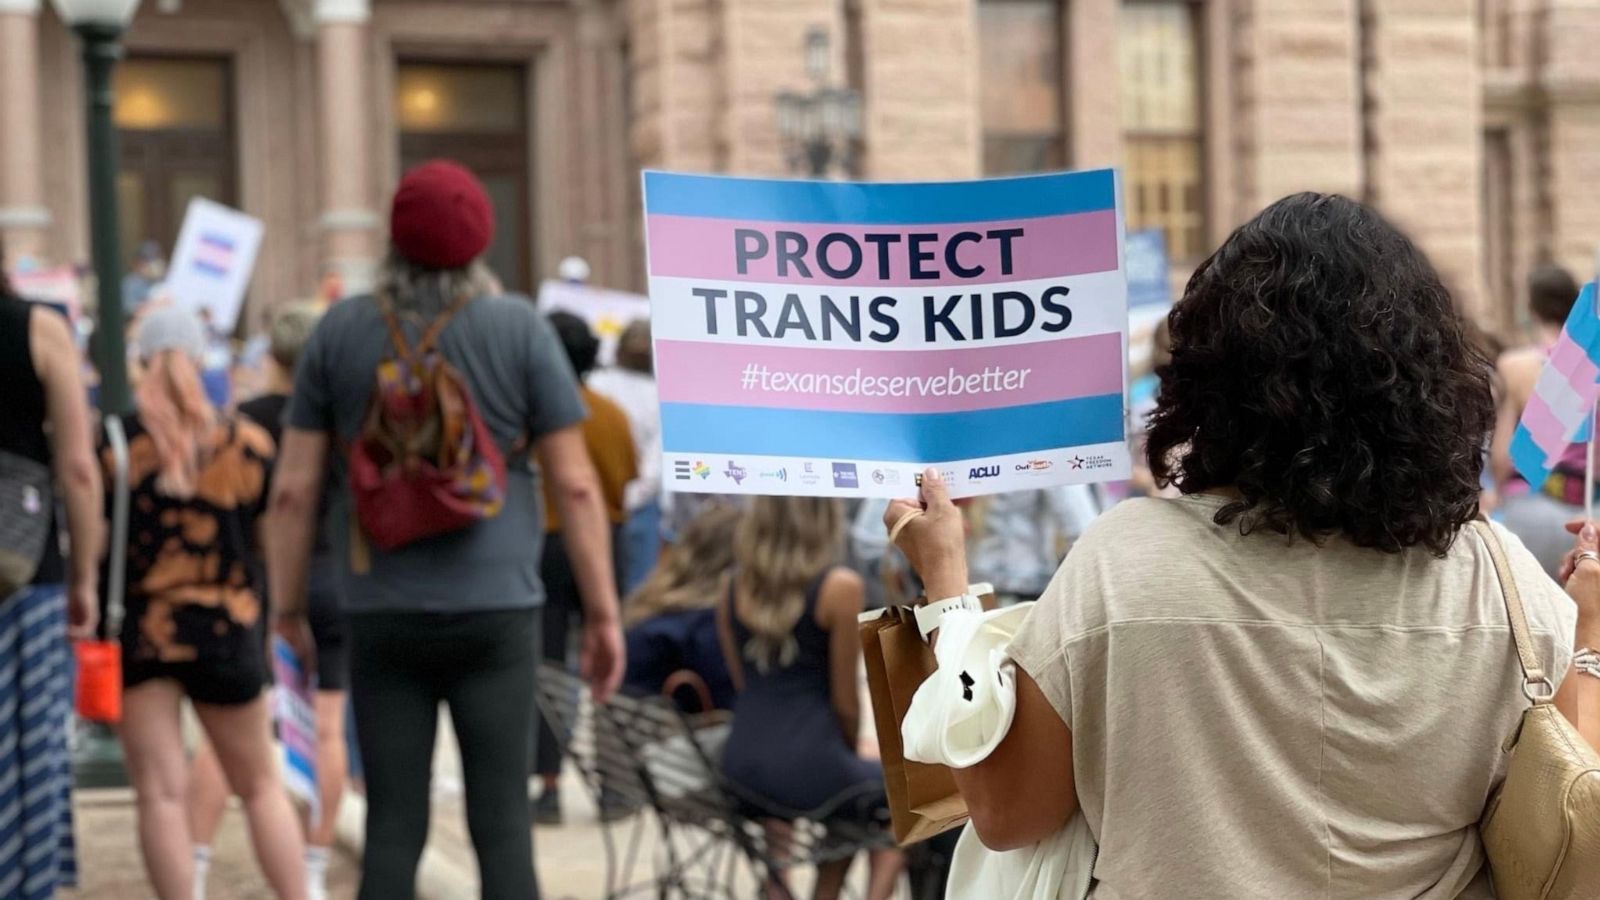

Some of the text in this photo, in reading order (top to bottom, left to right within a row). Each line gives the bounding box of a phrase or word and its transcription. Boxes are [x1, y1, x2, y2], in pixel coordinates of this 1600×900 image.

[733, 228, 1025, 281] PROTECT
[691, 286, 1073, 343] TRANS KIDS
[740, 363, 1032, 397] #texansdeservebetter
[968, 465, 1000, 479] ACLU
